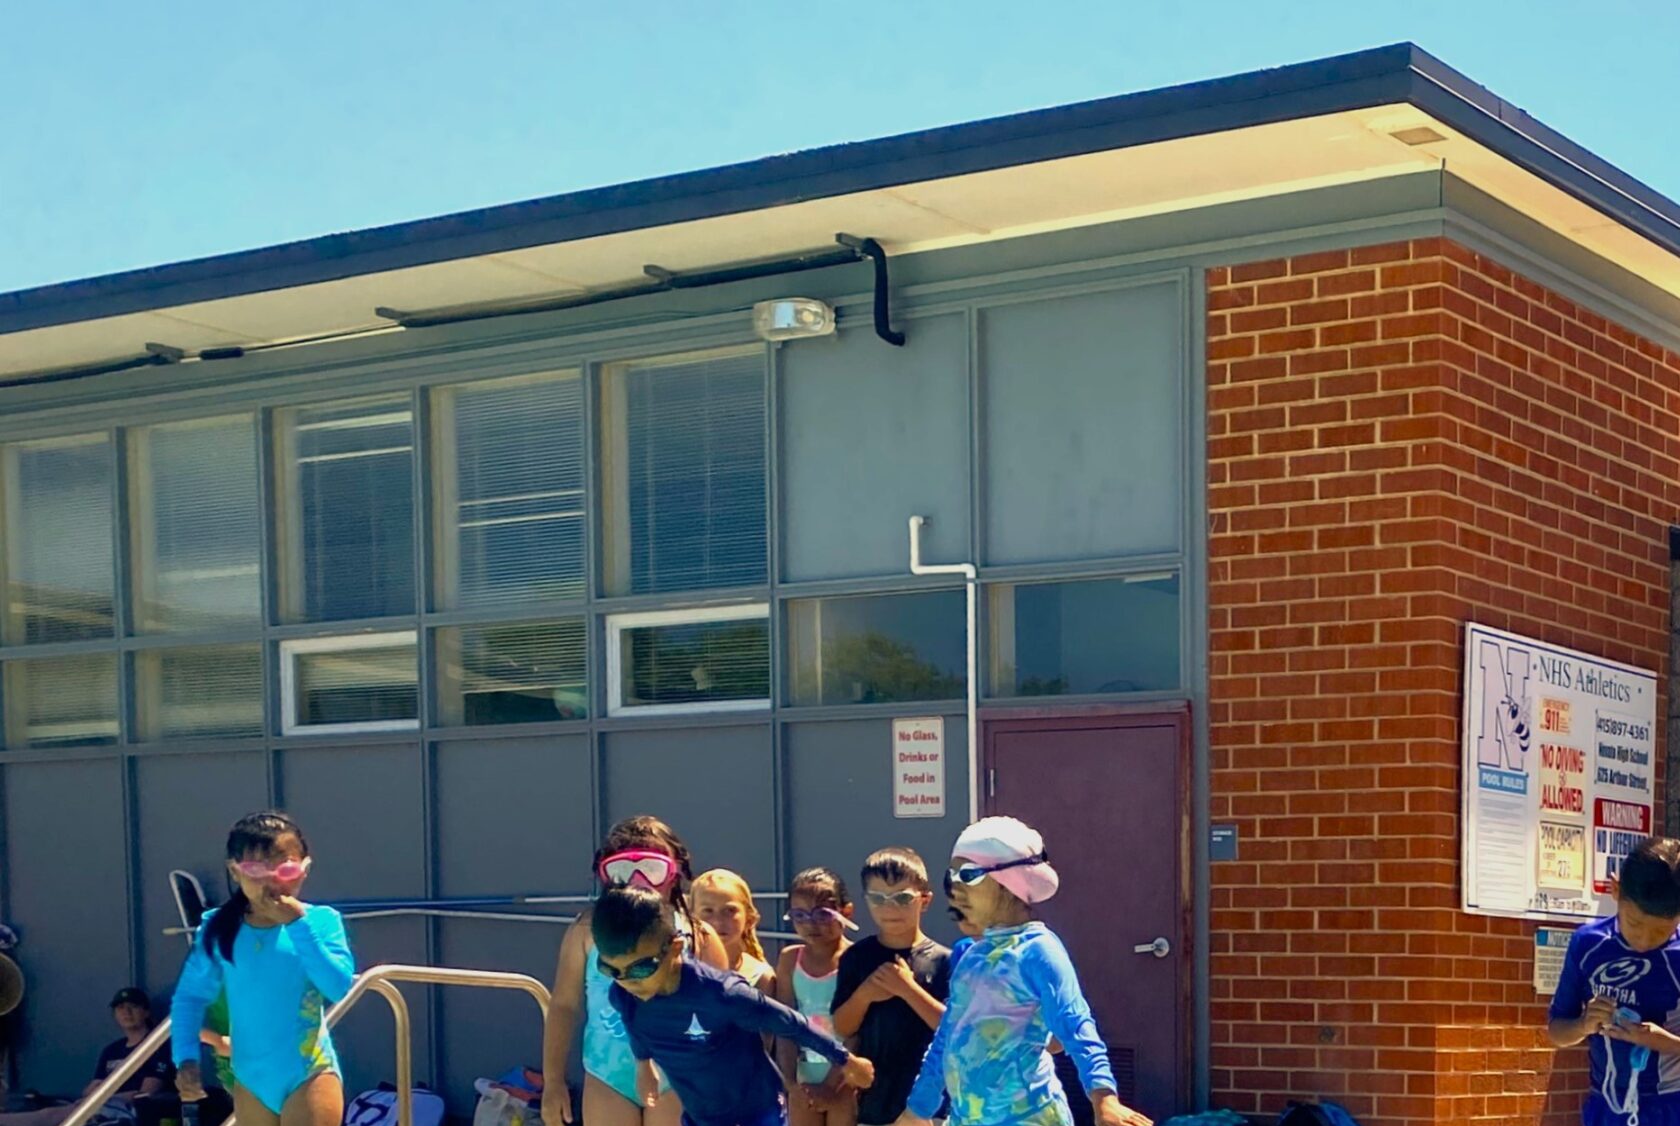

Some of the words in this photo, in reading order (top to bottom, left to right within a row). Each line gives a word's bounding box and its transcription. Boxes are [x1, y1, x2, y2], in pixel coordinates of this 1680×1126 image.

[1538, 655, 1572, 689] NHS
[1575, 667, 1632, 704] Athletics
[1545, 709, 1560, 732] 911
[898, 731, 911, 741] No
[898, 752, 927, 763] Drinks
[929, 753, 939, 762] or
[1541, 745, 1554, 769] NO
[1556, 746, 1584, 773] DIVING
[902, 772, 925, 784] Food
[926, 772, 935, 783] in
[1481, 771, 1501, 787] POOL
[1502, 775, 1525, 790] RULES
[898, 794, 919, 805] Pool
[920, 794, 940, 805] Area
[1542, 784, 1584, 812] ALLOWED
[1602, 800, 1644, 831] WARNING
[1597, 829, 1607, 853] NO
